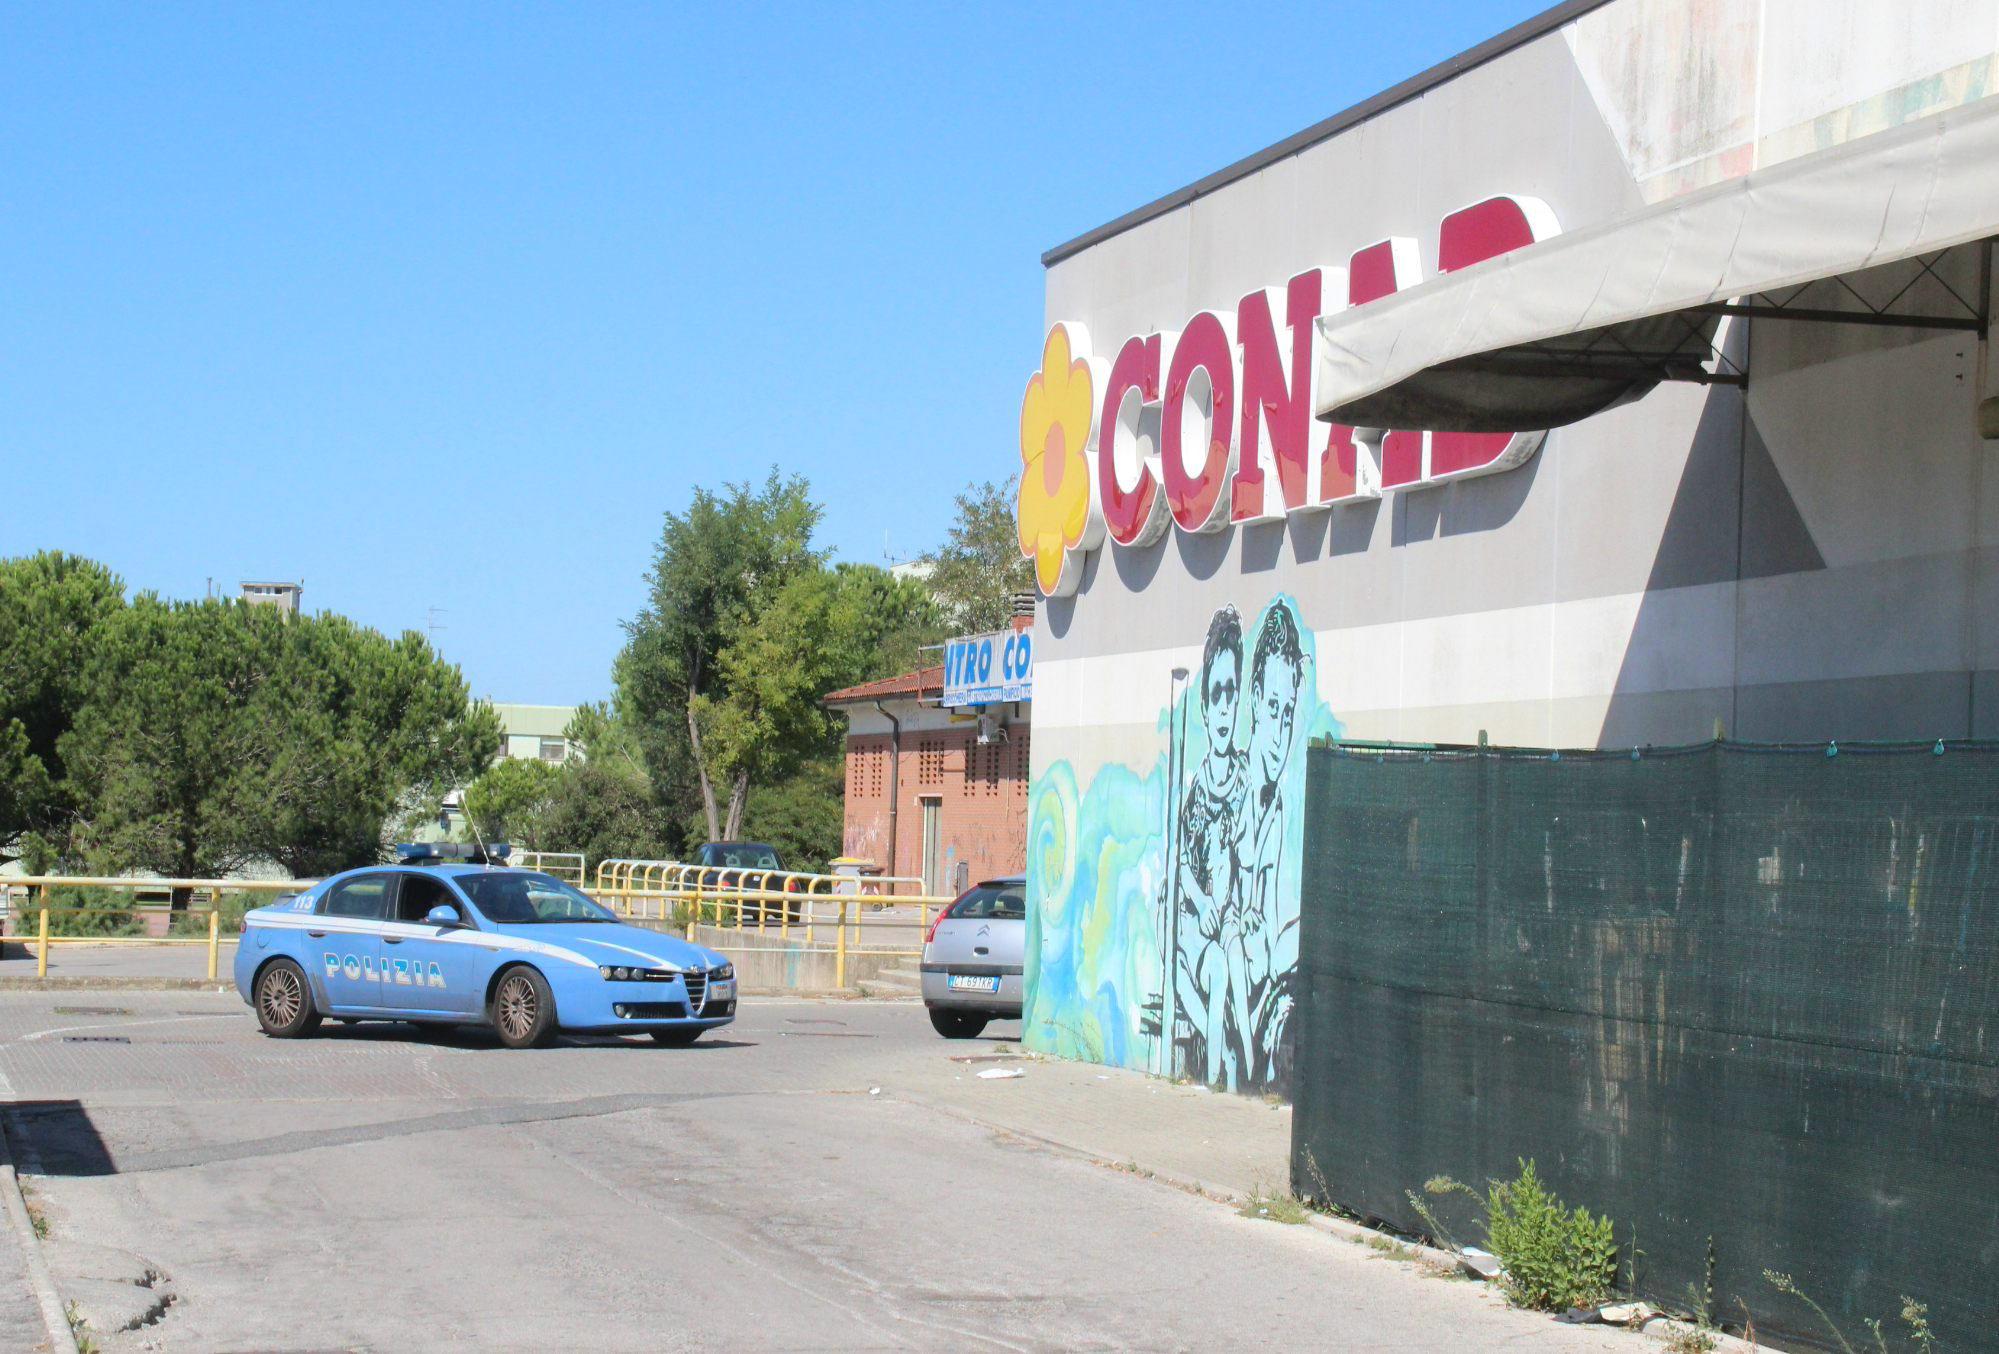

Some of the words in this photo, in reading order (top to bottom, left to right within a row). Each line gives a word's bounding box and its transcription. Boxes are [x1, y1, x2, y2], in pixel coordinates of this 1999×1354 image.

[1003, 634, 1033, 681] CO
[294, 895, 314, 909] 113
[324, 952, 447, 988] POLIZIA
